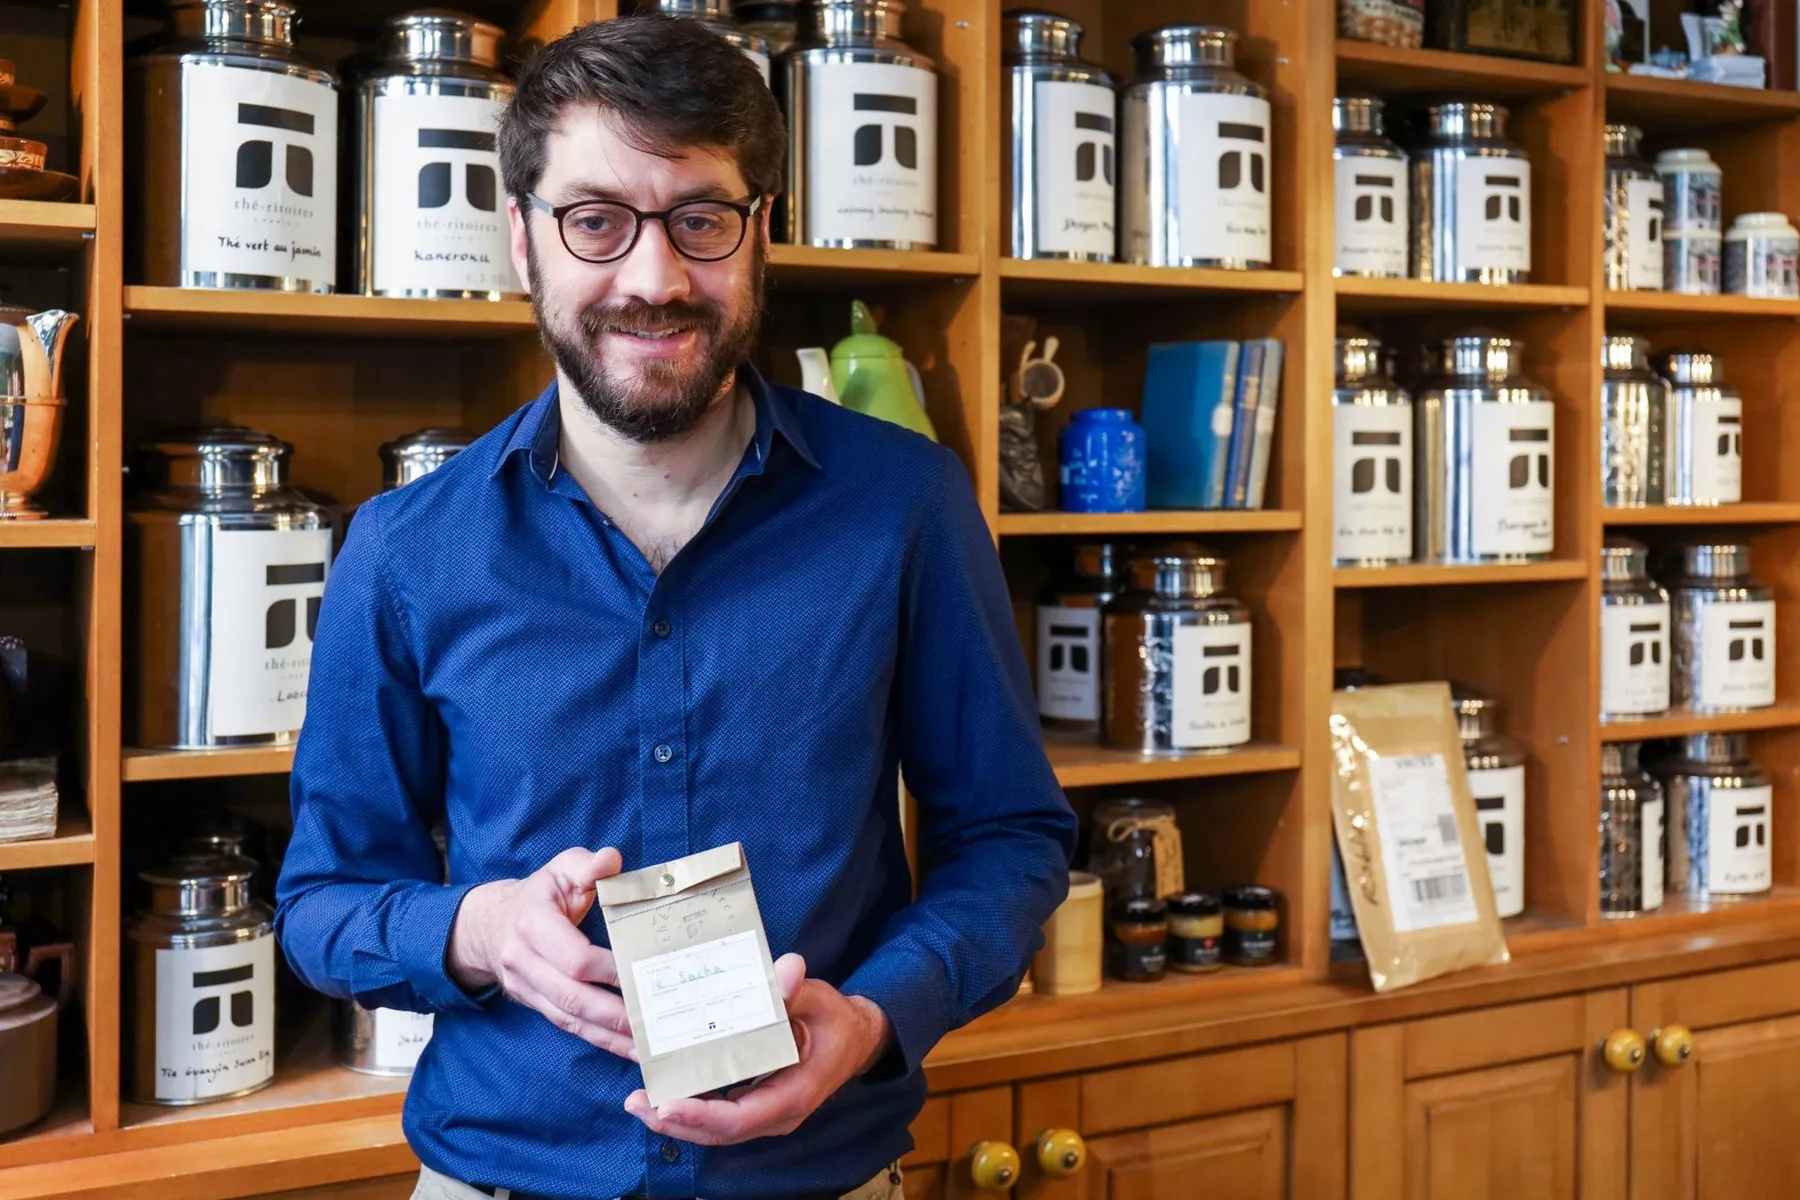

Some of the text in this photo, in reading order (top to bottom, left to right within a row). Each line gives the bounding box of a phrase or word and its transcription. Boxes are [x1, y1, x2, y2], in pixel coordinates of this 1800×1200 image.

[218, 236, 240, 249] Thé
[246, 239, 269, 251] vert
[274, 244, 287, 252] au
